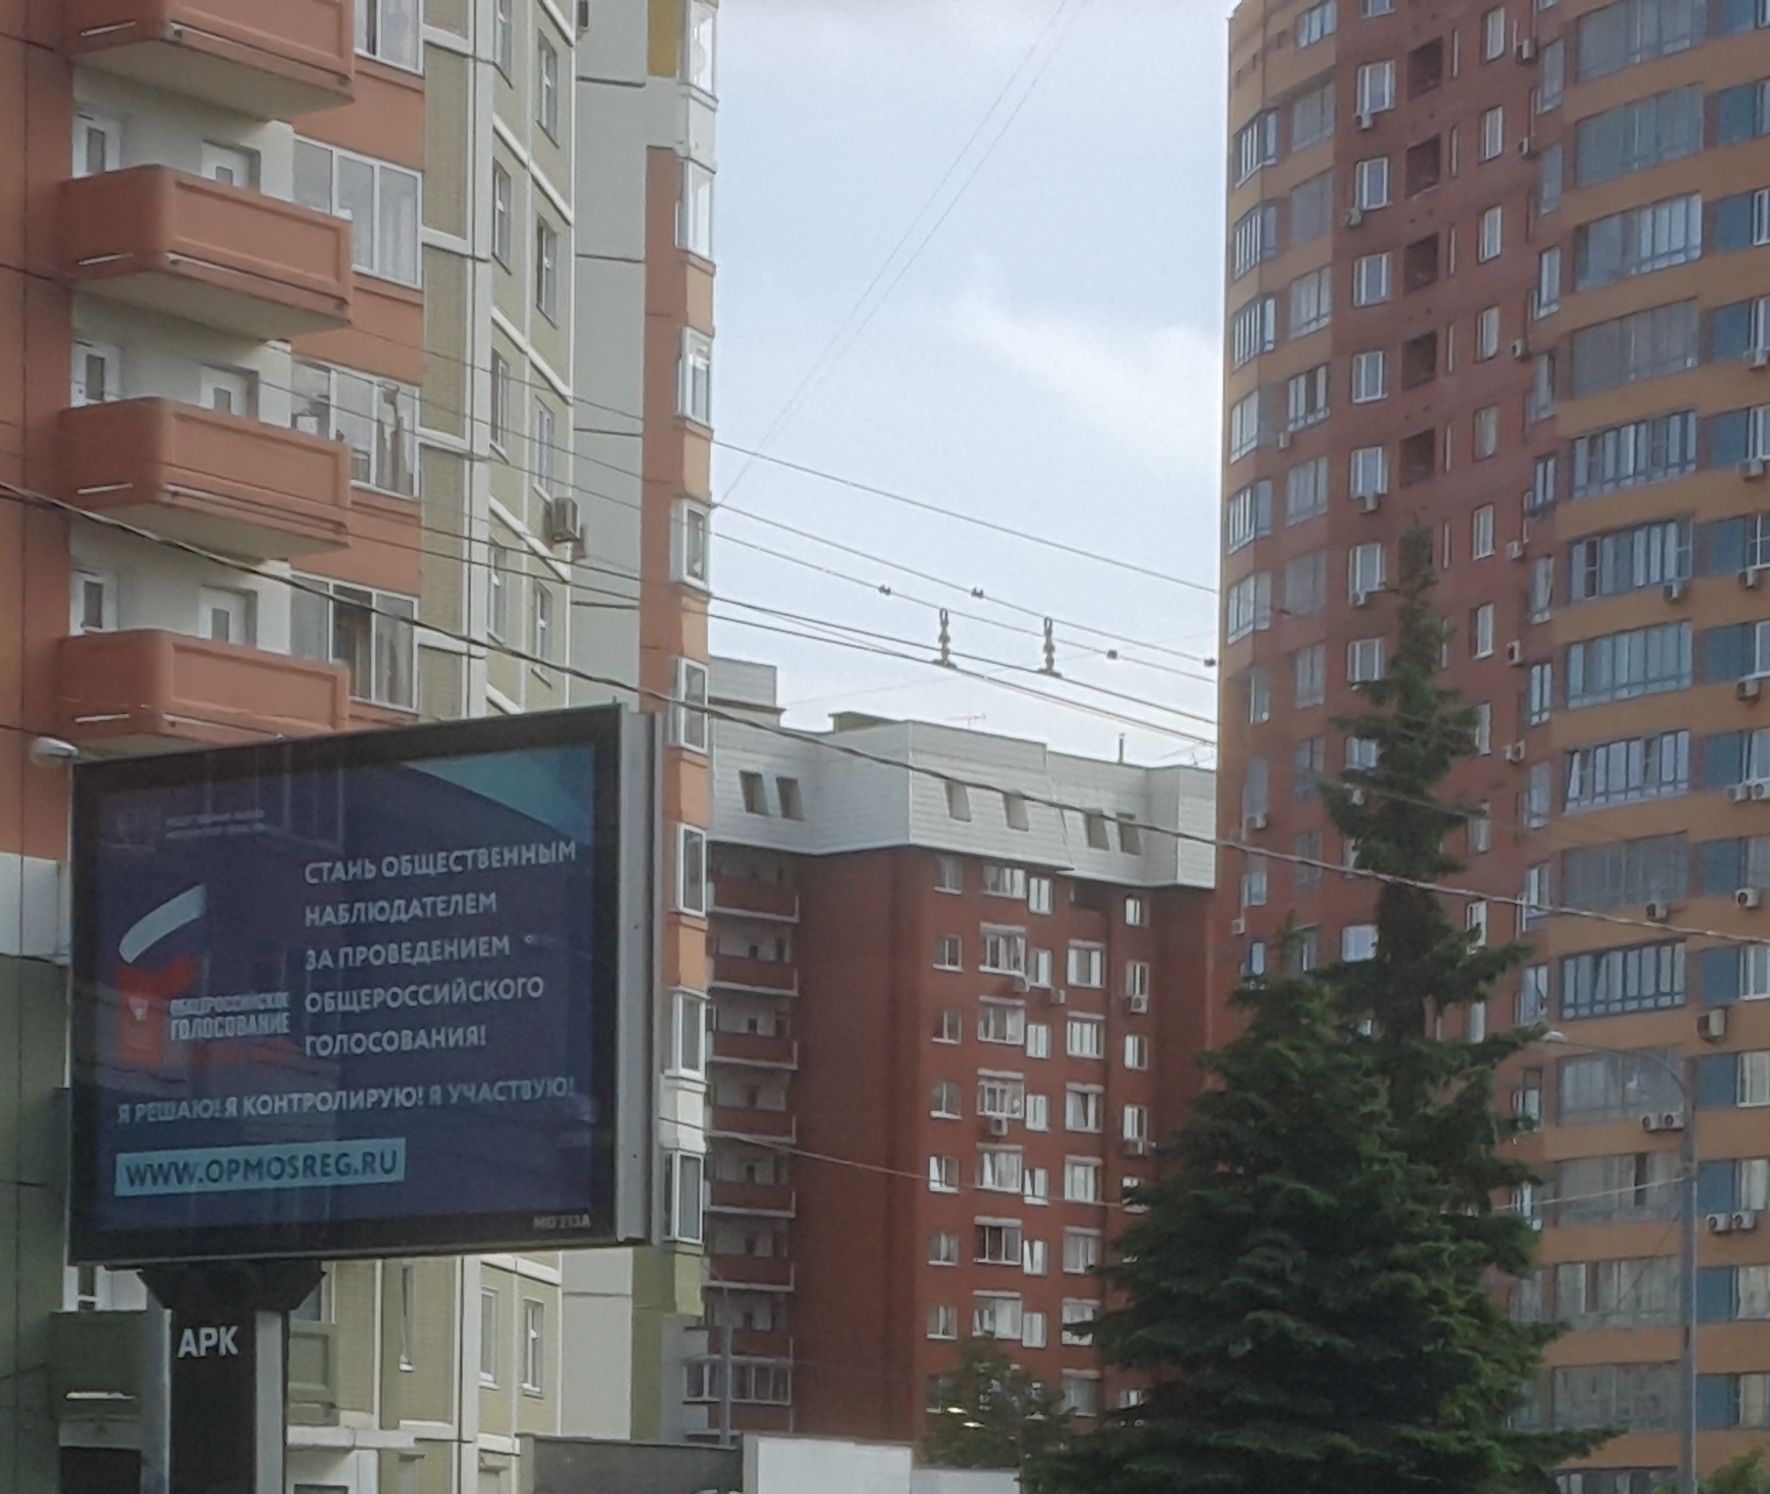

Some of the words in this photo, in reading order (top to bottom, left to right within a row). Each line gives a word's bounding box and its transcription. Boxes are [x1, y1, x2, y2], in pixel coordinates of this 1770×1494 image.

[304, 859, 377, 885] СТАНЬ
[381, 840, 577, 878] ОБЩЕСТВЕННЫМ
[304, 892, 498, 928] НАБЛЮДАТЕЛЕМ
[304, 949, 335, 972] ЗА
[338, 935, 511, 970] ПРОВЕДЕНИЕМ
[304, 976, 545, 1015] ОБЩЕРОССИЙСКОГО
[170, 1011, 291, 1042] ГОЛОСОВАНИЕ
[304, 1024, 487, 1058] ГОЛОСОВАНИЯ!
[117, 1103, 131, 1125] Я
[225, 1096, 239, 1119] Я
[243, 1085, 425, 1117] КОНТРОЛИРУЮ!
[429, 1084, 443, 1107] Я
[447, 1076, 576, 1105] УЧАСТВУЮ!
[126, 1150, 397, 1188] WWW.OPMOSREG.RU
